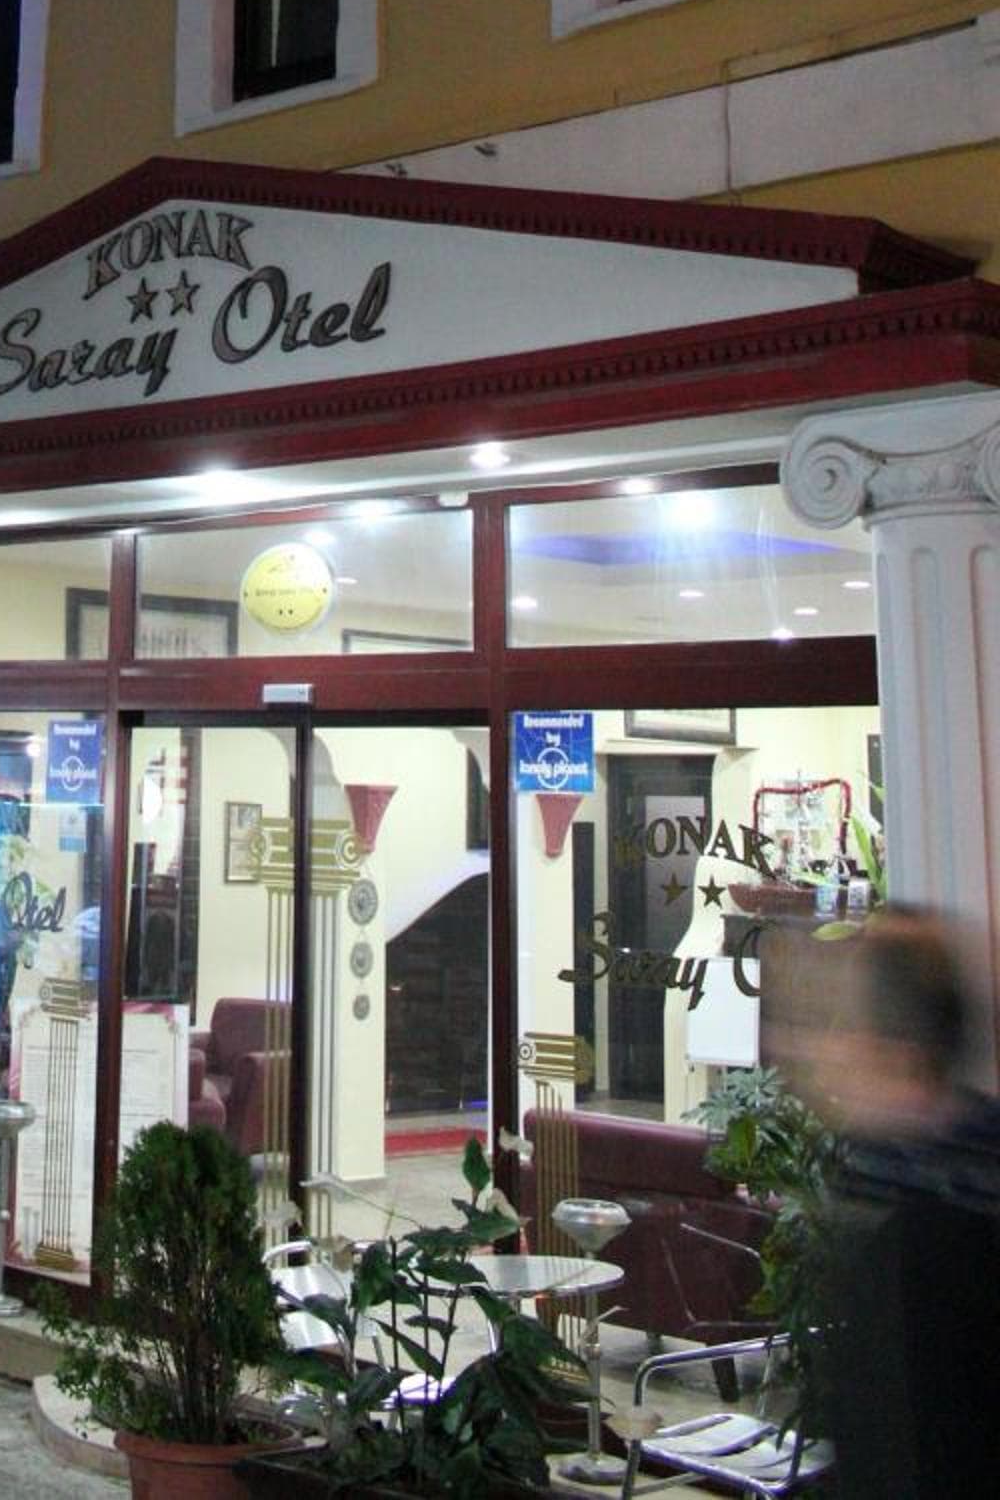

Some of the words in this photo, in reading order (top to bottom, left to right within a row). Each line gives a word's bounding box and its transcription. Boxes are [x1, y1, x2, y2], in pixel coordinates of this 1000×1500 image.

[83, 209, 254, 301] KONAK
[212, 261, 391, 364] Otel
[523, 713, 584, 729] Recommended
[545, 731, 561, 747] by
[519, 760, 552, 779] lonely
[553, 760, 588, 779] planet
